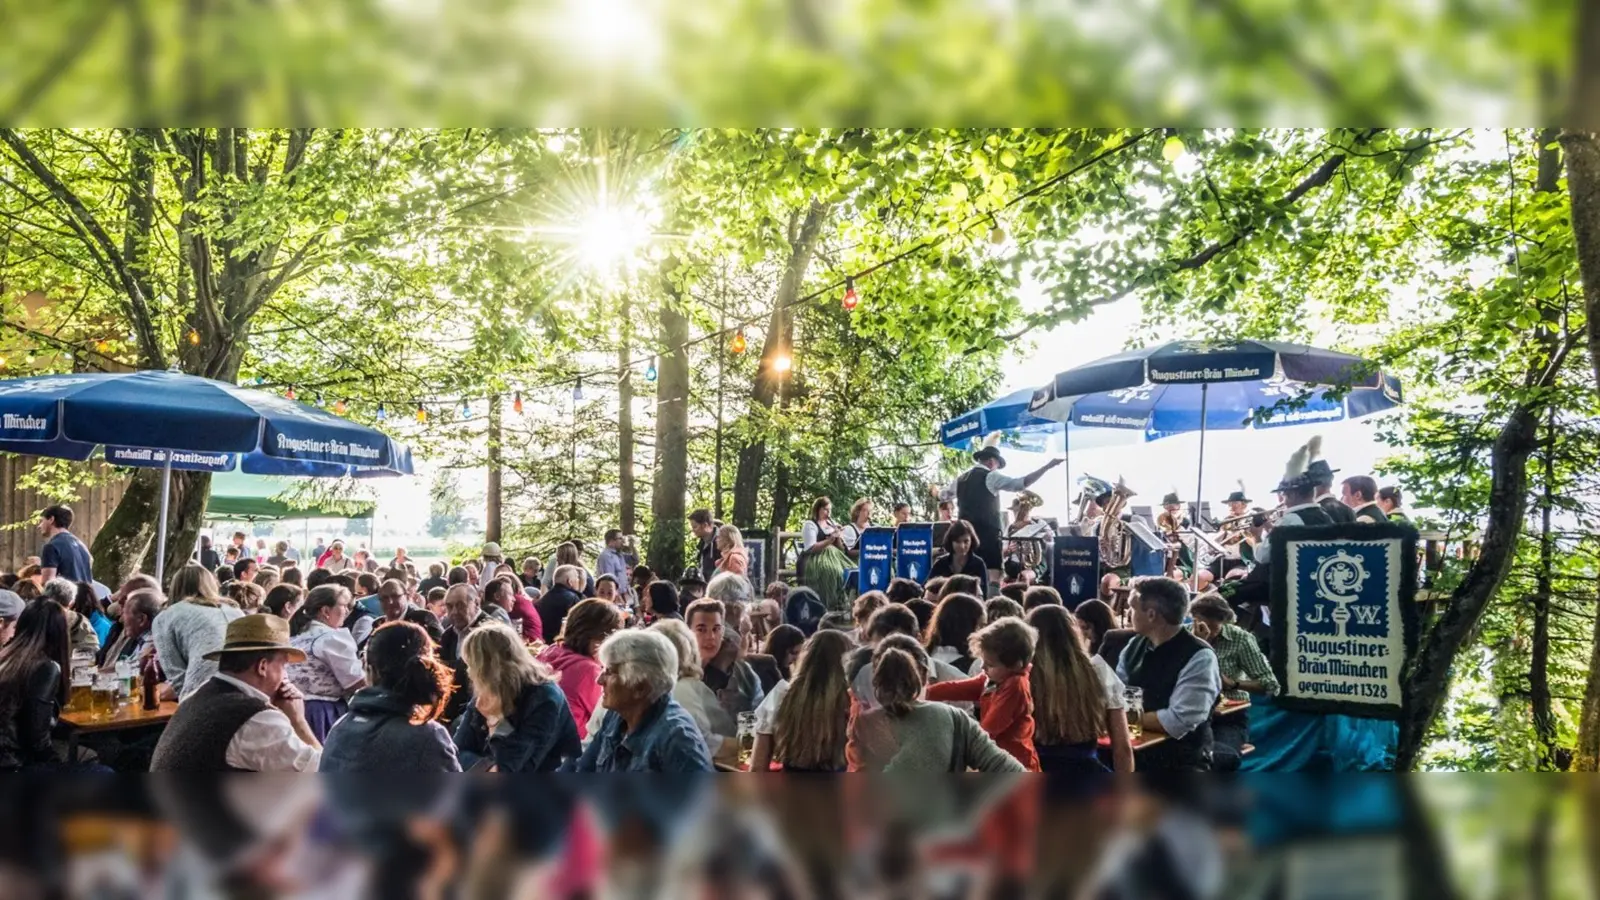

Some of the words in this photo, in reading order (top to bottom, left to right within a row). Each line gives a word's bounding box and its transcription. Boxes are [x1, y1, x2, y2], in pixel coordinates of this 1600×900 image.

[1224, 367, 1260, 378] München
[3, 413, 47, 430] München
[349, 442, 380, 458] München
[1305, 604, 1329, 624] J.
[1351, 605, 1381, 625] W.
[1298, 680, 1359, 696] gegründet
[1361, 684, 1388, 699] 1328
